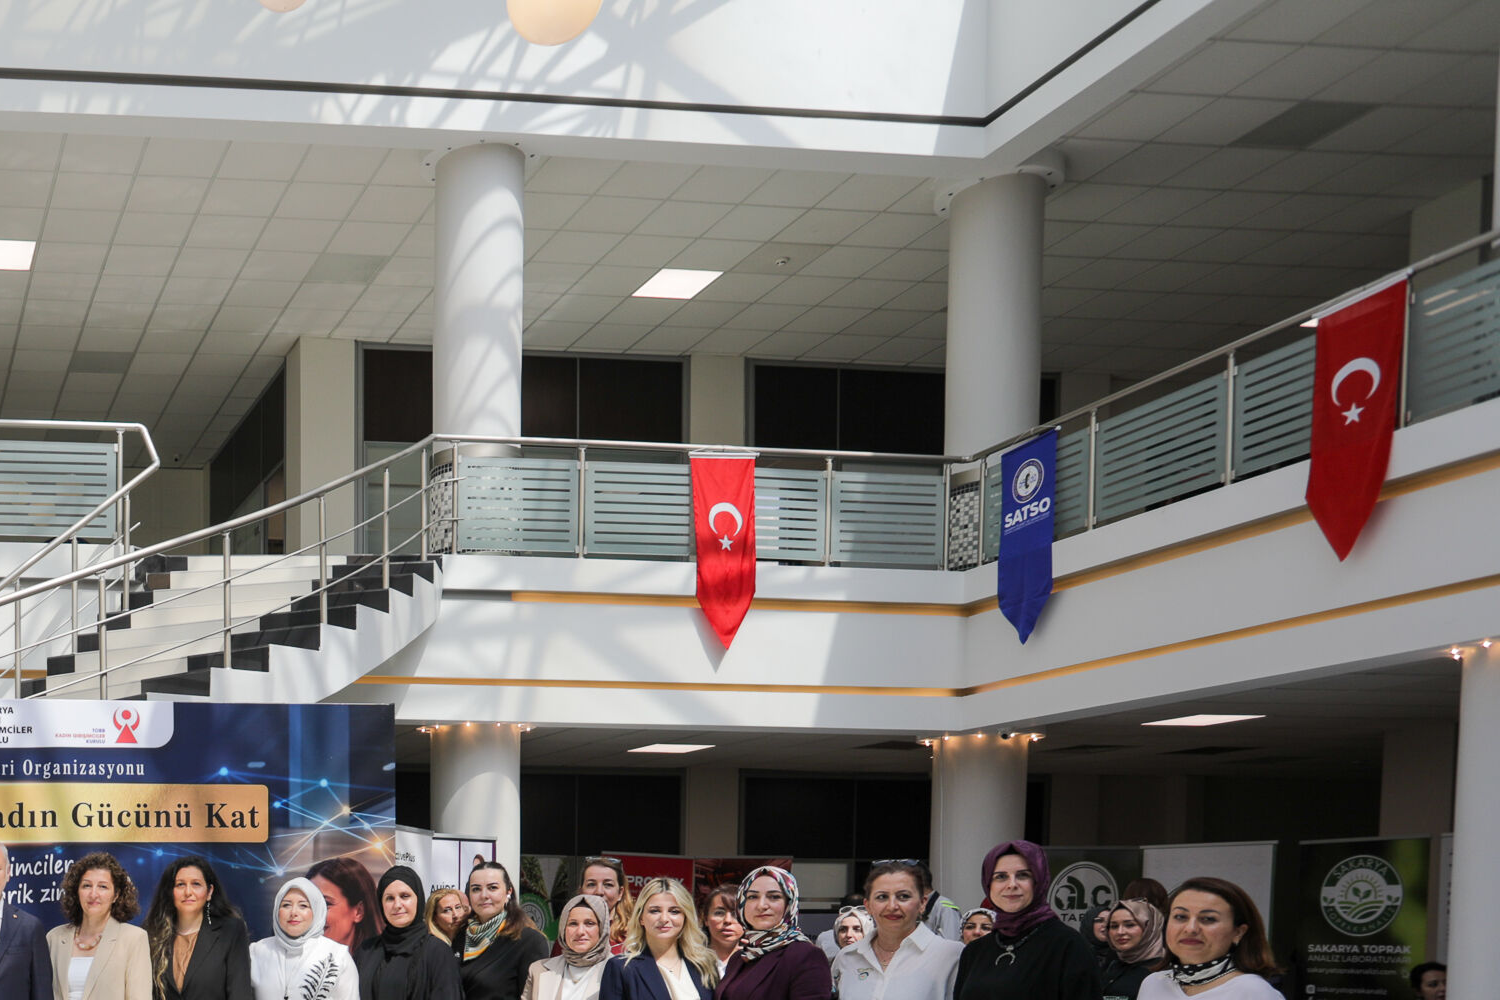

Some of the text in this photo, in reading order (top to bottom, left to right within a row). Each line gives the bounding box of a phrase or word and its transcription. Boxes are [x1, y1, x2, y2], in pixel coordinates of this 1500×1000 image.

[1004, 497, 1051, 528] SATSO
[22, 759, 146, 780] Organizasyonu
[71, 802, 192, 829] Gücünü
[204, 803, 260, 829] Kat
[10, 854, 75, 877] imciler
[1332, 858, 1389, 879] SAKARYA
[1307, 944, 1412, 954] SAKARYA TOPRAK
[1341, 955, 1412, 964] LABORATUVARI
